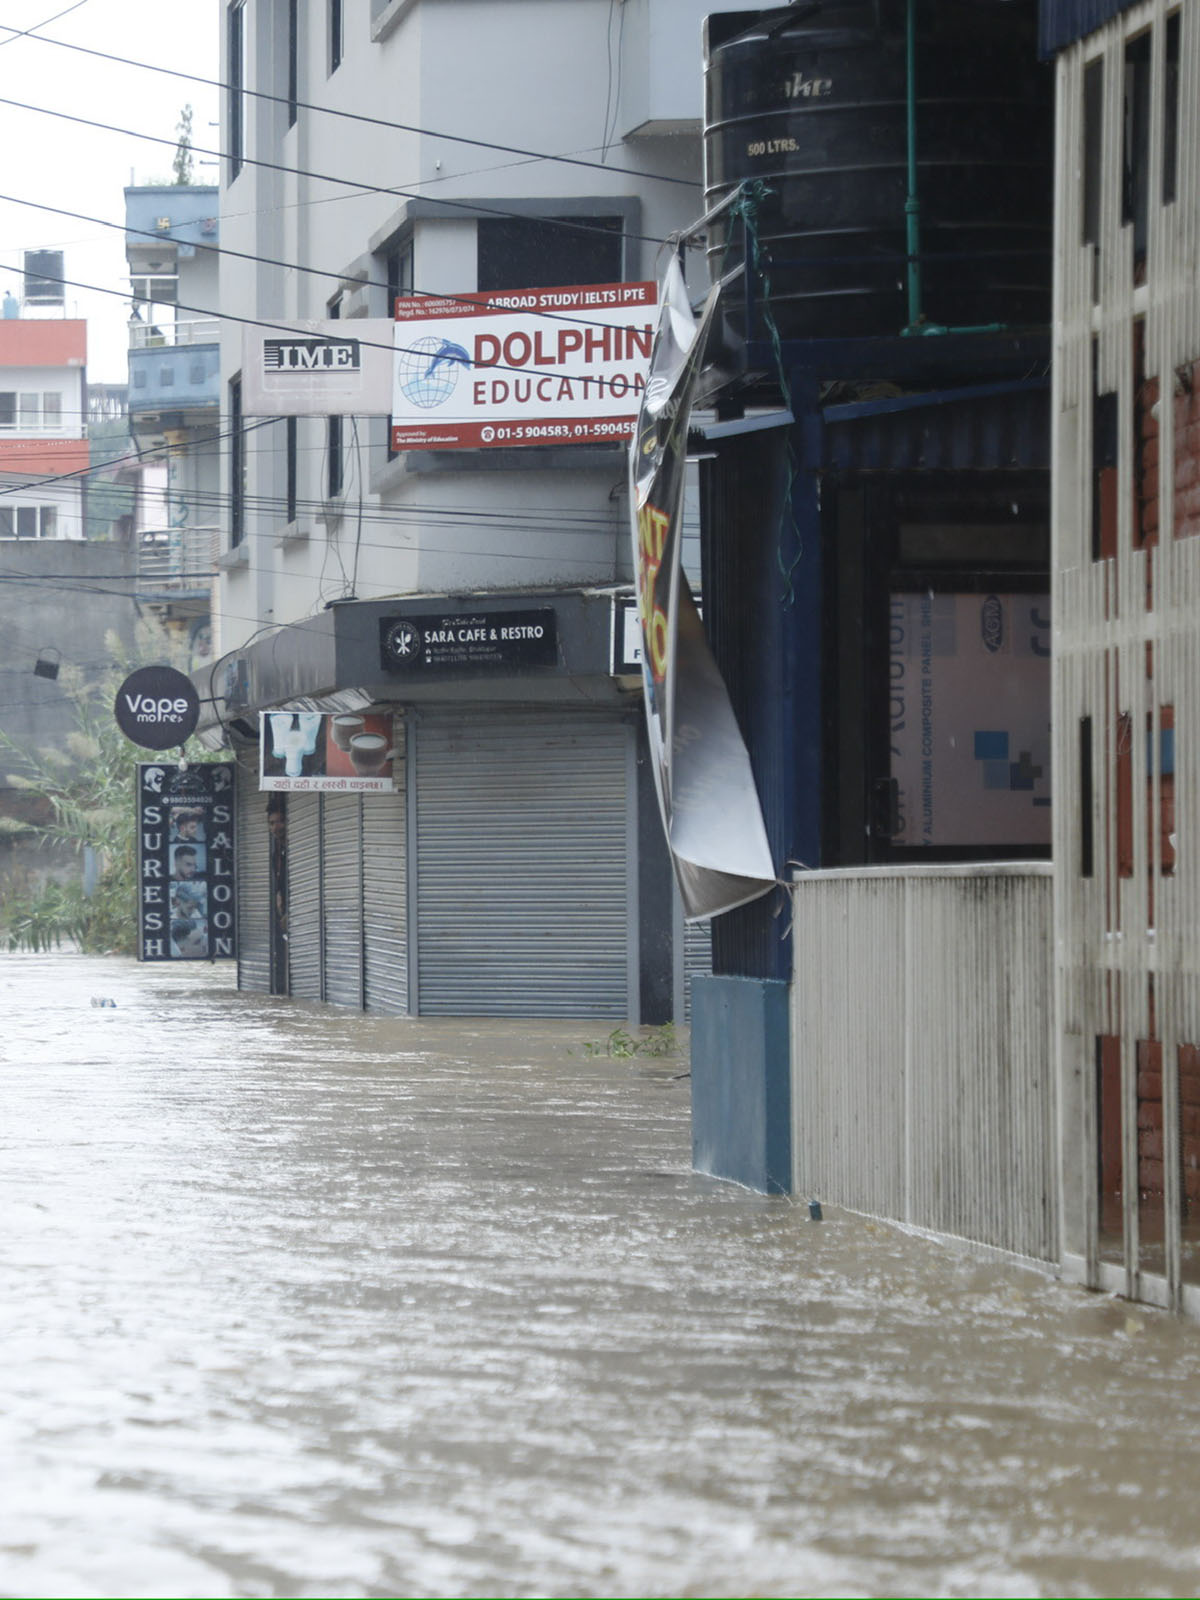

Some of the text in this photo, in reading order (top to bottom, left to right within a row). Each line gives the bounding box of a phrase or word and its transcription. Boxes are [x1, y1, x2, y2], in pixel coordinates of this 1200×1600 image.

[748, 139, 800, 156] 500 LTRS.
[486, 288, 645, 310] ABROAD STUDY IELTS PTE
[280, 346, 352, 368] IME
[474, 324, 652, 369] DOLPHIN
[474, 373, 647, 405] EDUCATION
[424, 626, 544, 643] SARA CAFE & RESTRO
[922, 632, 932, 674] PANEL
[125, 694, 188, 721] Vape
[922, 678, 932, 757] COMPOSITE
[313, 781, 319, 789] र
[922, 760, 932, 834] ALUMINIUM
[143, 806, 164, 957] SURESH
[210, 805, 232, 956] SALOON
